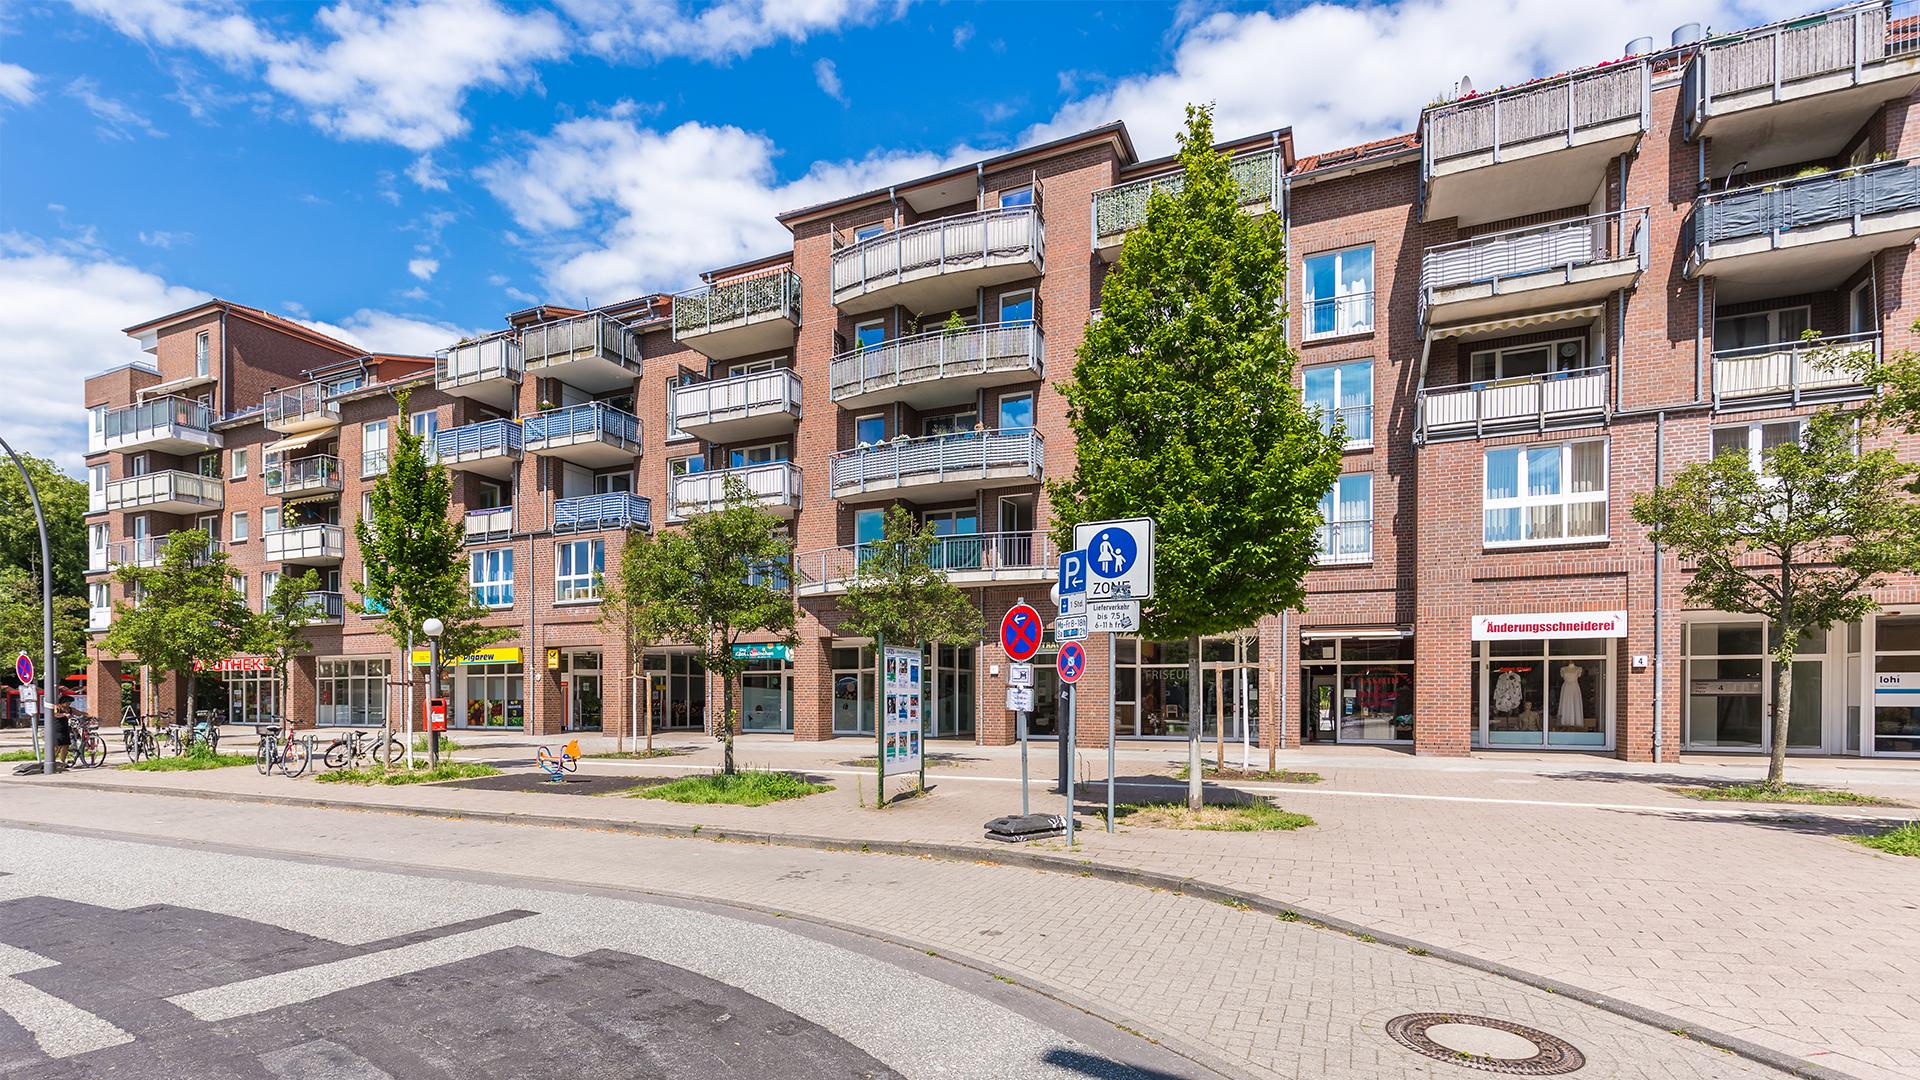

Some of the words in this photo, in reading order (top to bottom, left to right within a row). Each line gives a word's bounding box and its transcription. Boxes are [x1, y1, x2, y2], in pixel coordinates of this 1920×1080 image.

[1065, 557, 1080, 589] P
[1093, 603, 1130, 611] Lieferverkehr
[1487, 620, 1615, 633] Änderungsschneiderei
[1638, 657, 1643, 665] 4
[1879, 674, 1900, 683] lohi
